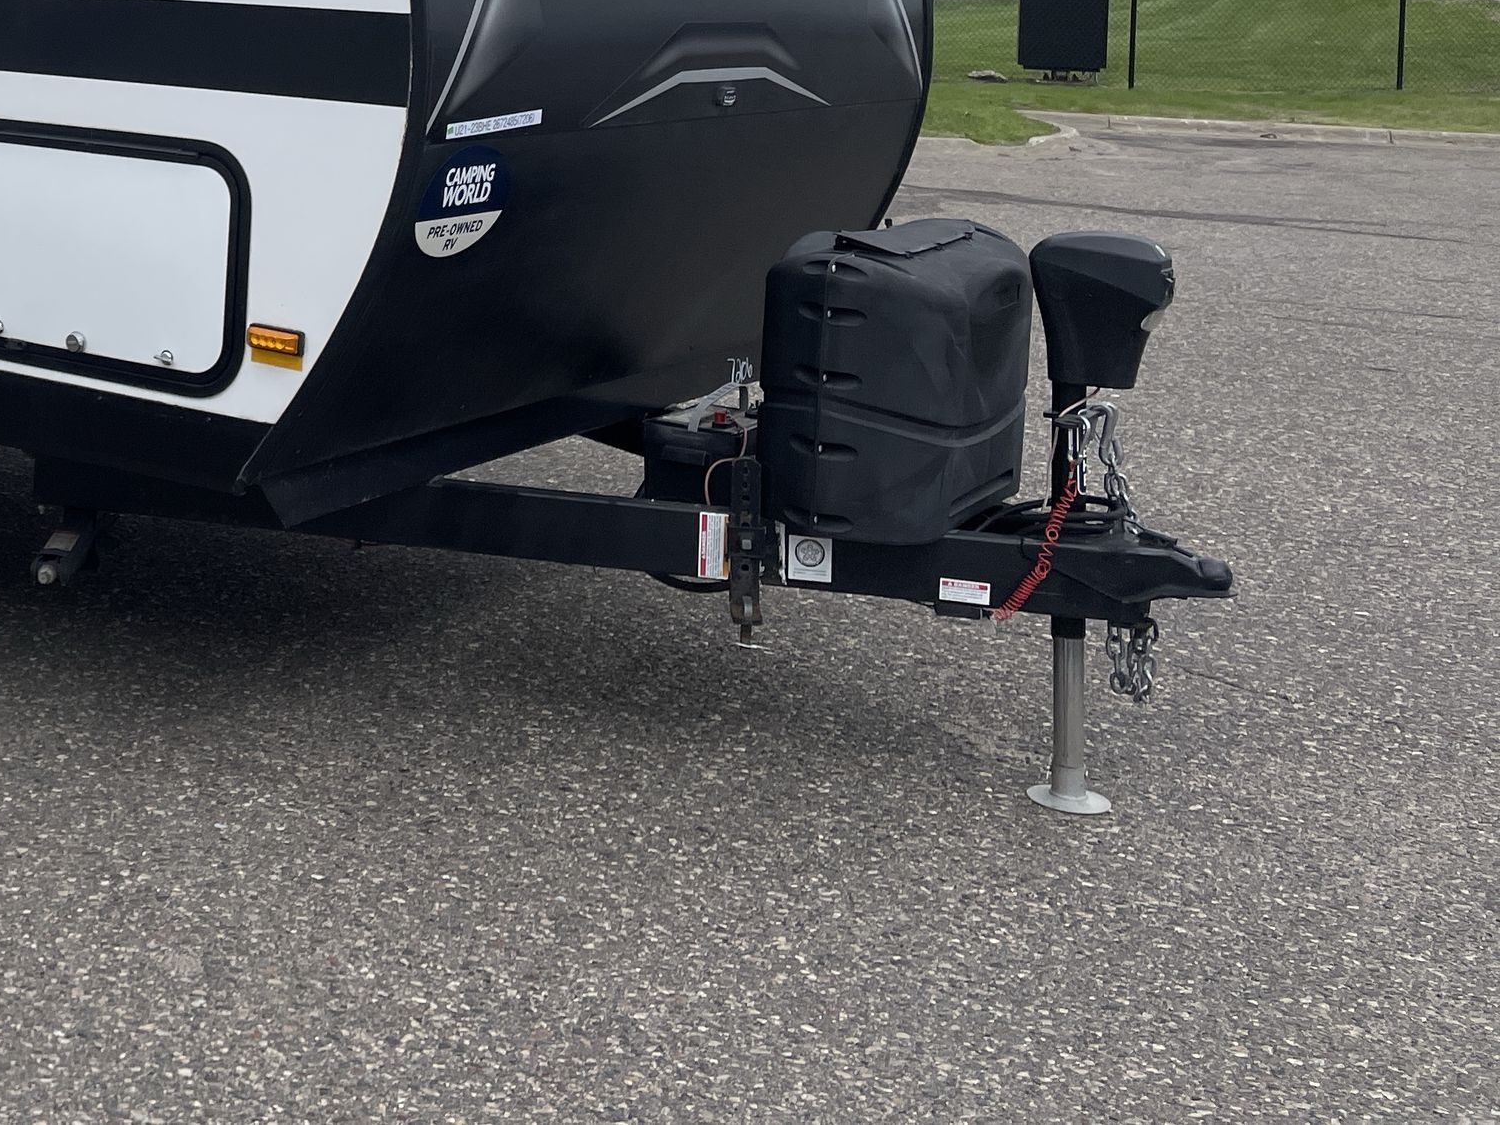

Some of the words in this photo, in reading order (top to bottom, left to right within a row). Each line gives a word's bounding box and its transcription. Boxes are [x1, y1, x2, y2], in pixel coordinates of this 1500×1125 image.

[446, 163, 496, 186] CAMPING
[442, 182, 491, 208] WORLD
[426, 219, 483, 239] PRE-OWNED
[442, 237, 458, 251] RV
